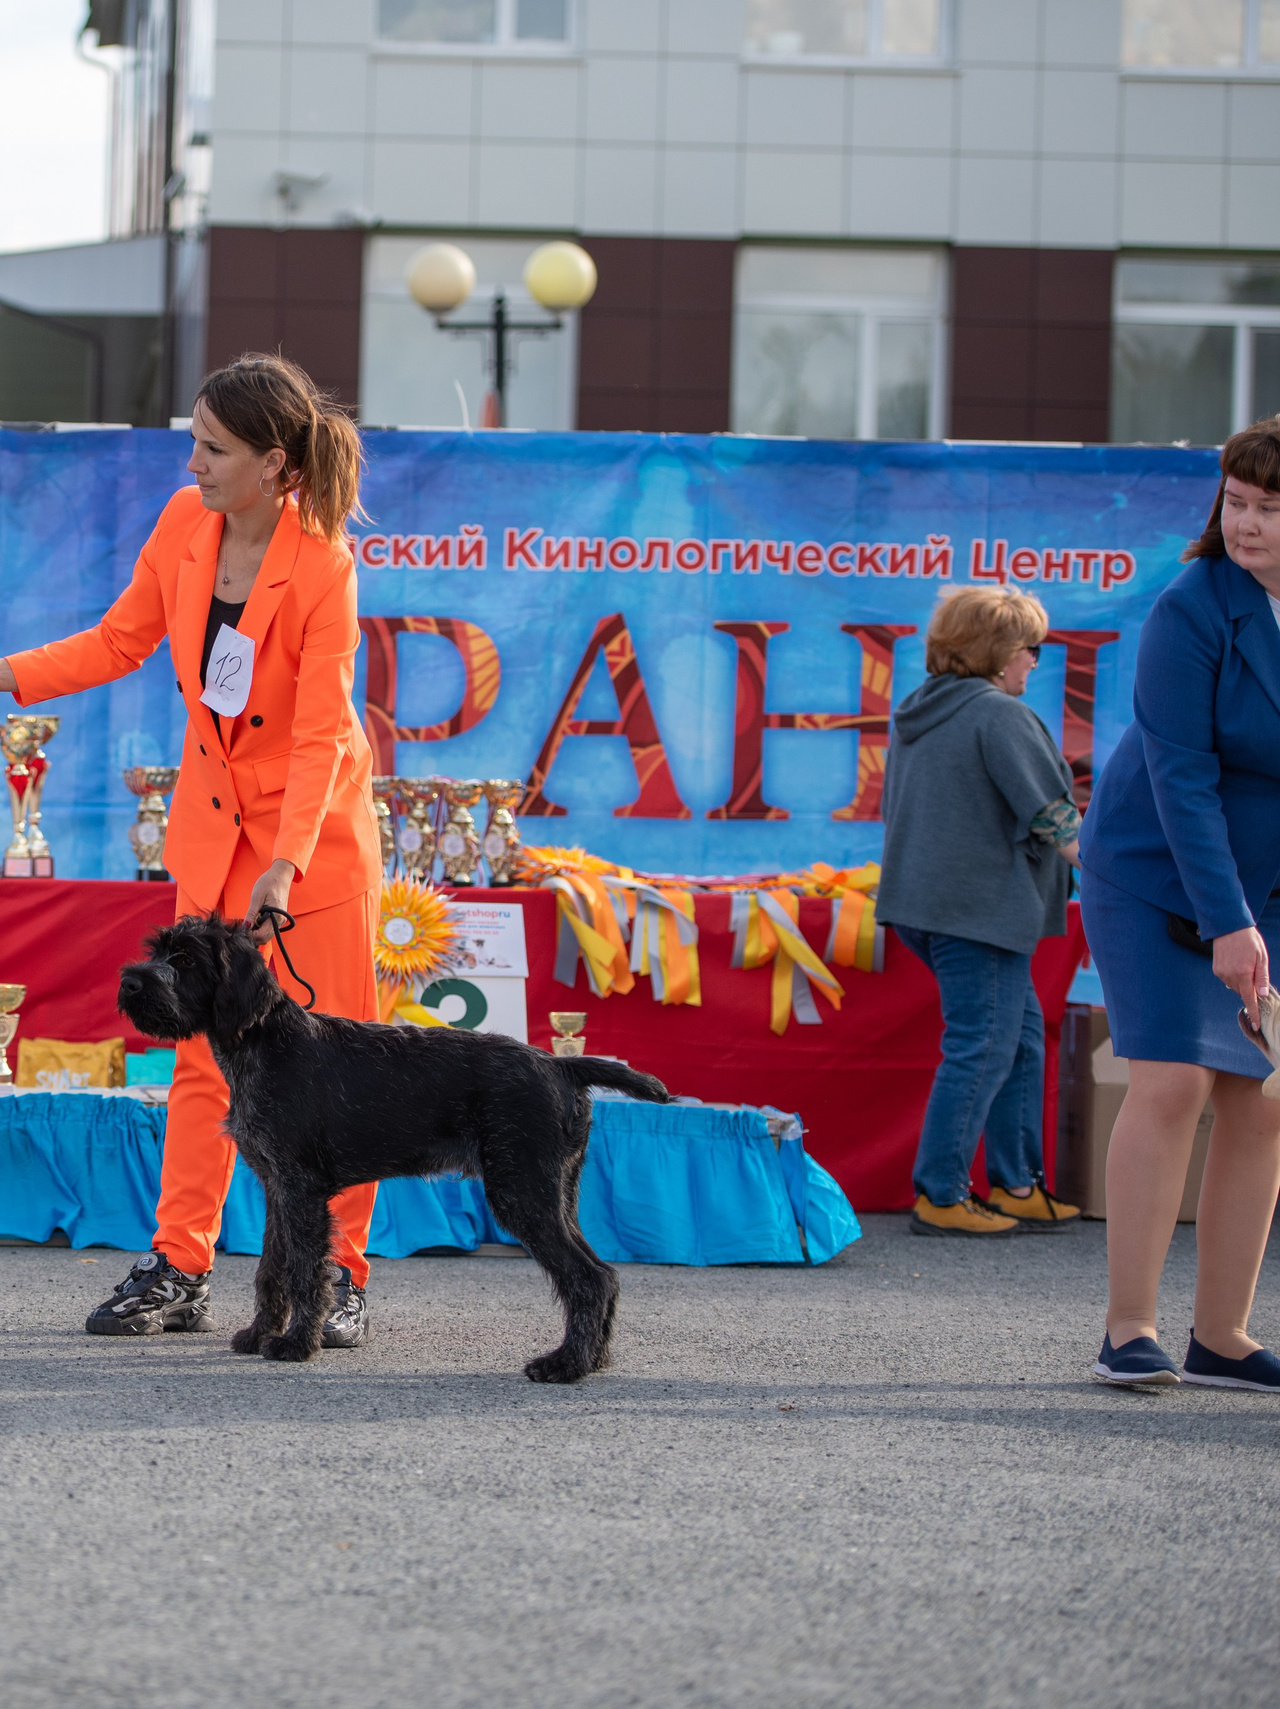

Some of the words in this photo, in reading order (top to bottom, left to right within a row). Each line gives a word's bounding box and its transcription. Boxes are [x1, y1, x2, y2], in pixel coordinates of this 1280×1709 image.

[506, 528, 952, 578] Кинологический
[970, 539, 1136, 590] Центр
[215, 651, 243, 692] 12
